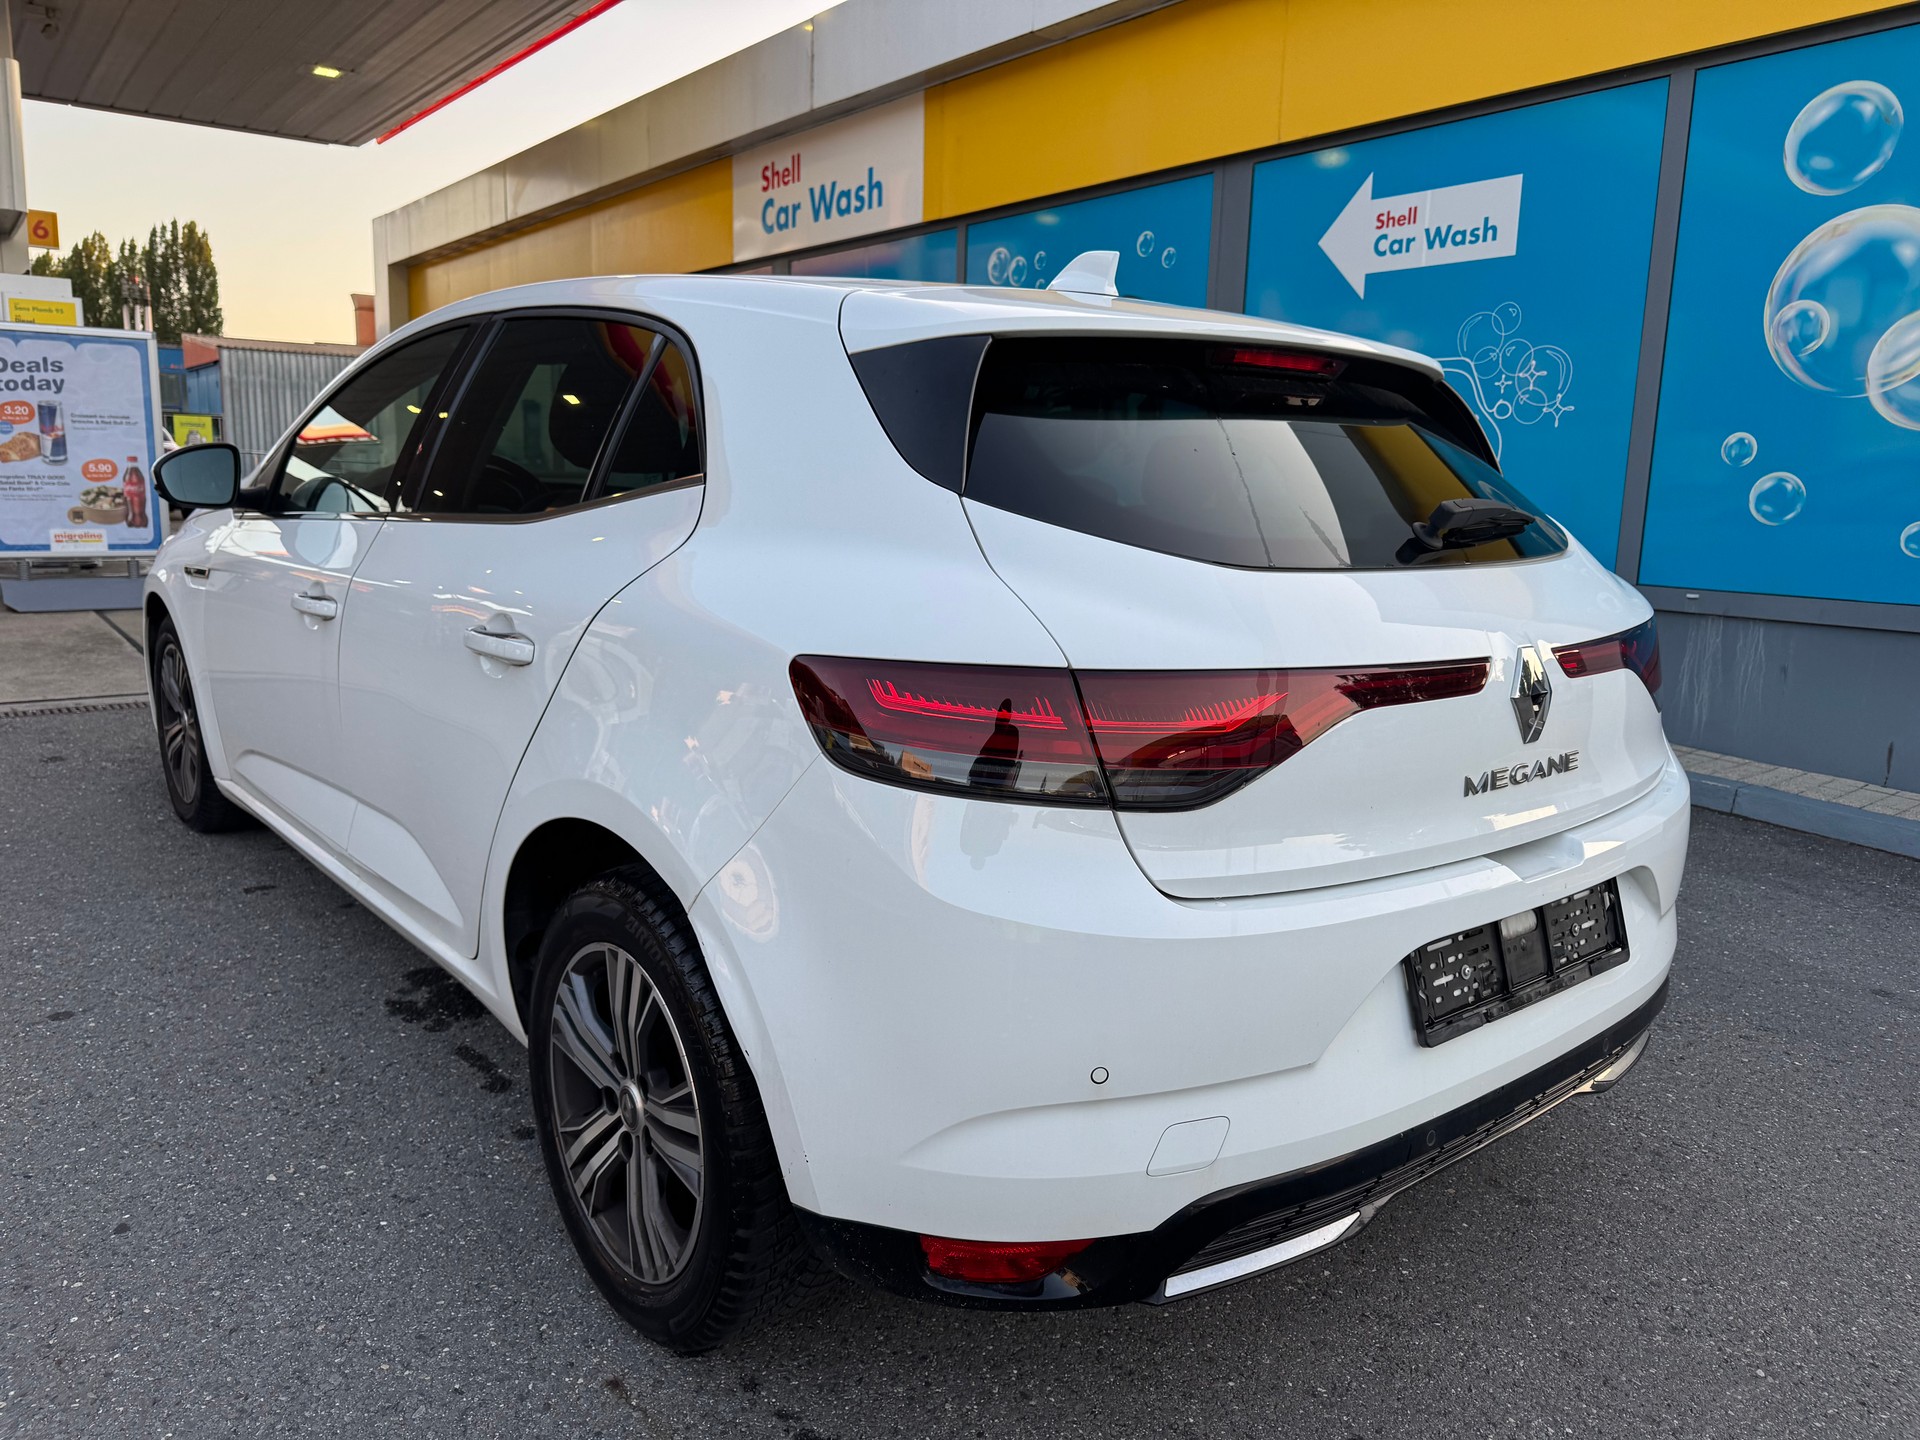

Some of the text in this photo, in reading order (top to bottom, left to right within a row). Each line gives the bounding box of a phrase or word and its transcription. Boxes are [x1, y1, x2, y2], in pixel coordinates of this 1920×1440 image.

[761, 153, 801, 192] Shell
[762, 166, 883, 234] Car Wash
[32, 220, 49, 239] 6
[1375, 206, 1418, 230] Shell
[1373, 216, 1498, 257] Car Wash
[4, 405, 29, 415] 3.20
[88, 464, 112, 473] 5.90
[54, 531, 103, 540] migrolino
[1463, 750, 1579, 797] MEGANE
